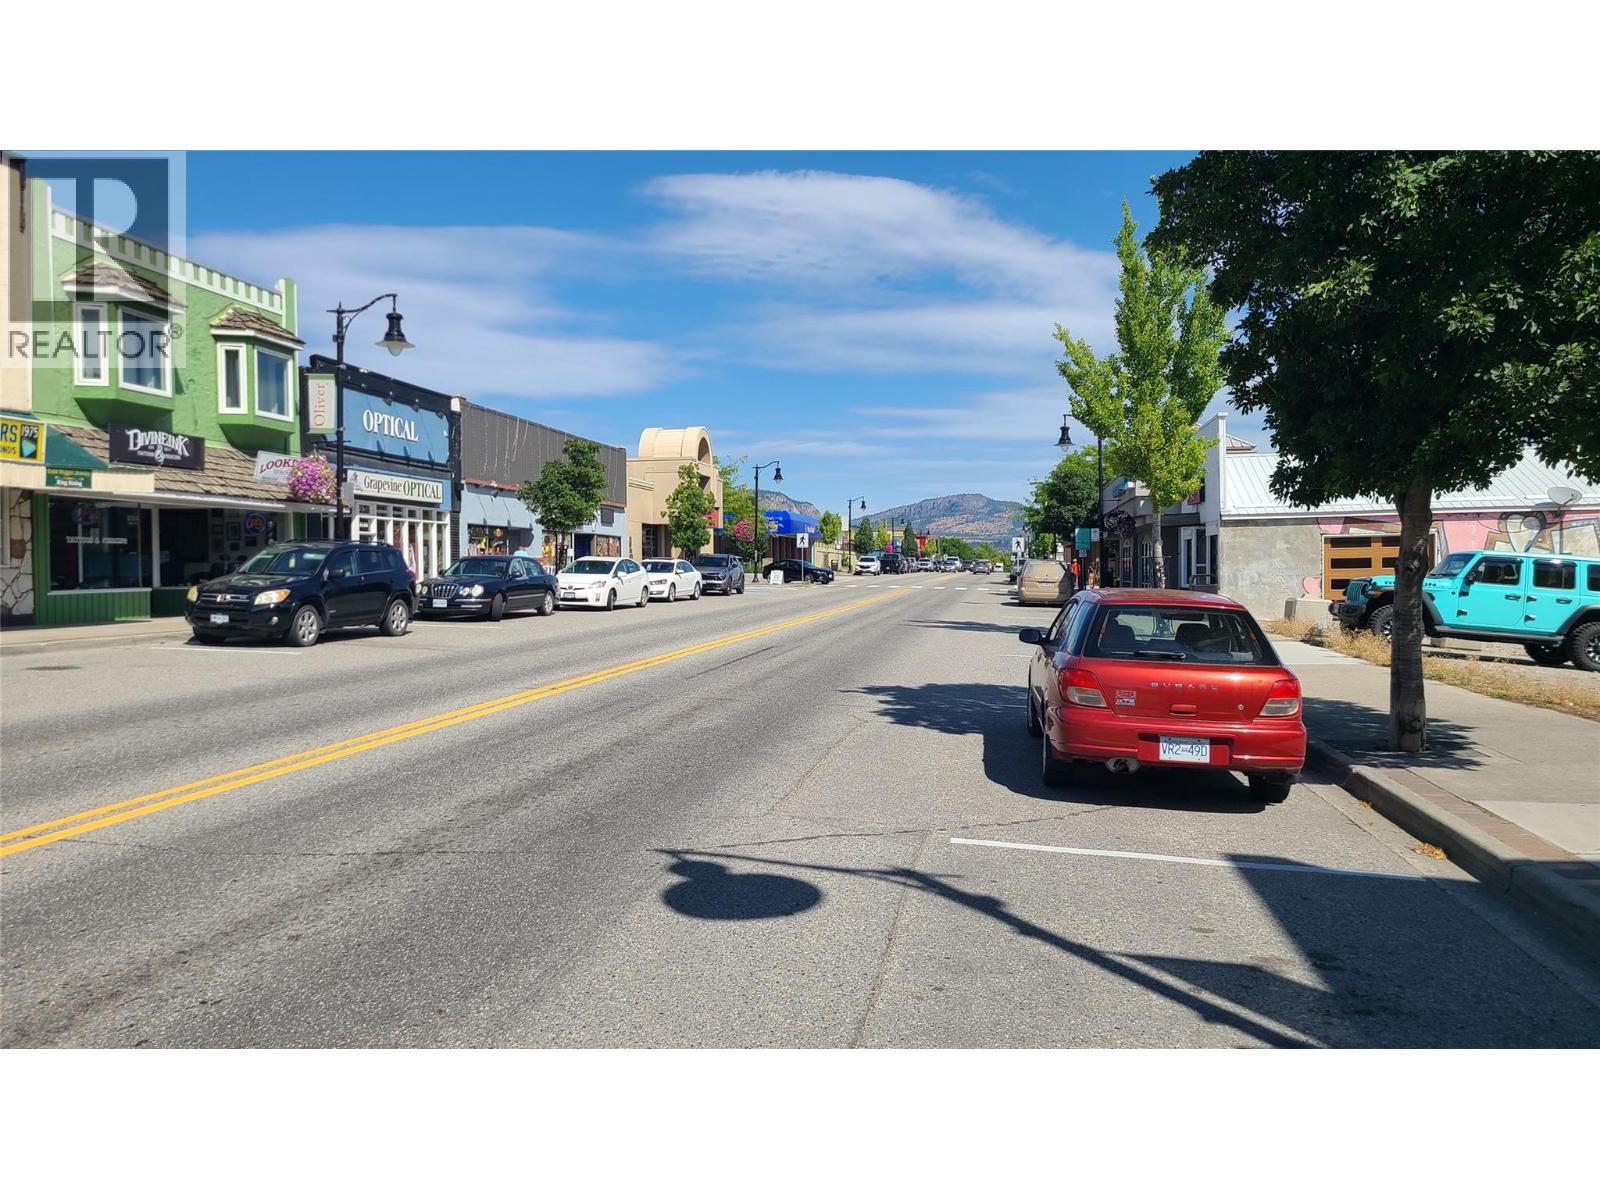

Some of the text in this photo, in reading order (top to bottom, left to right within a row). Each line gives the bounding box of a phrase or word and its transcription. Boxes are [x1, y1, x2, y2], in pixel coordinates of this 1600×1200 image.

[313, 383, 326, 427] Oliver
[21, 425, 39, 439] 1975
[363, 409, 419, 442] OPTICAL
[363, 476, 442, 500] Grapevine OPTICAL
